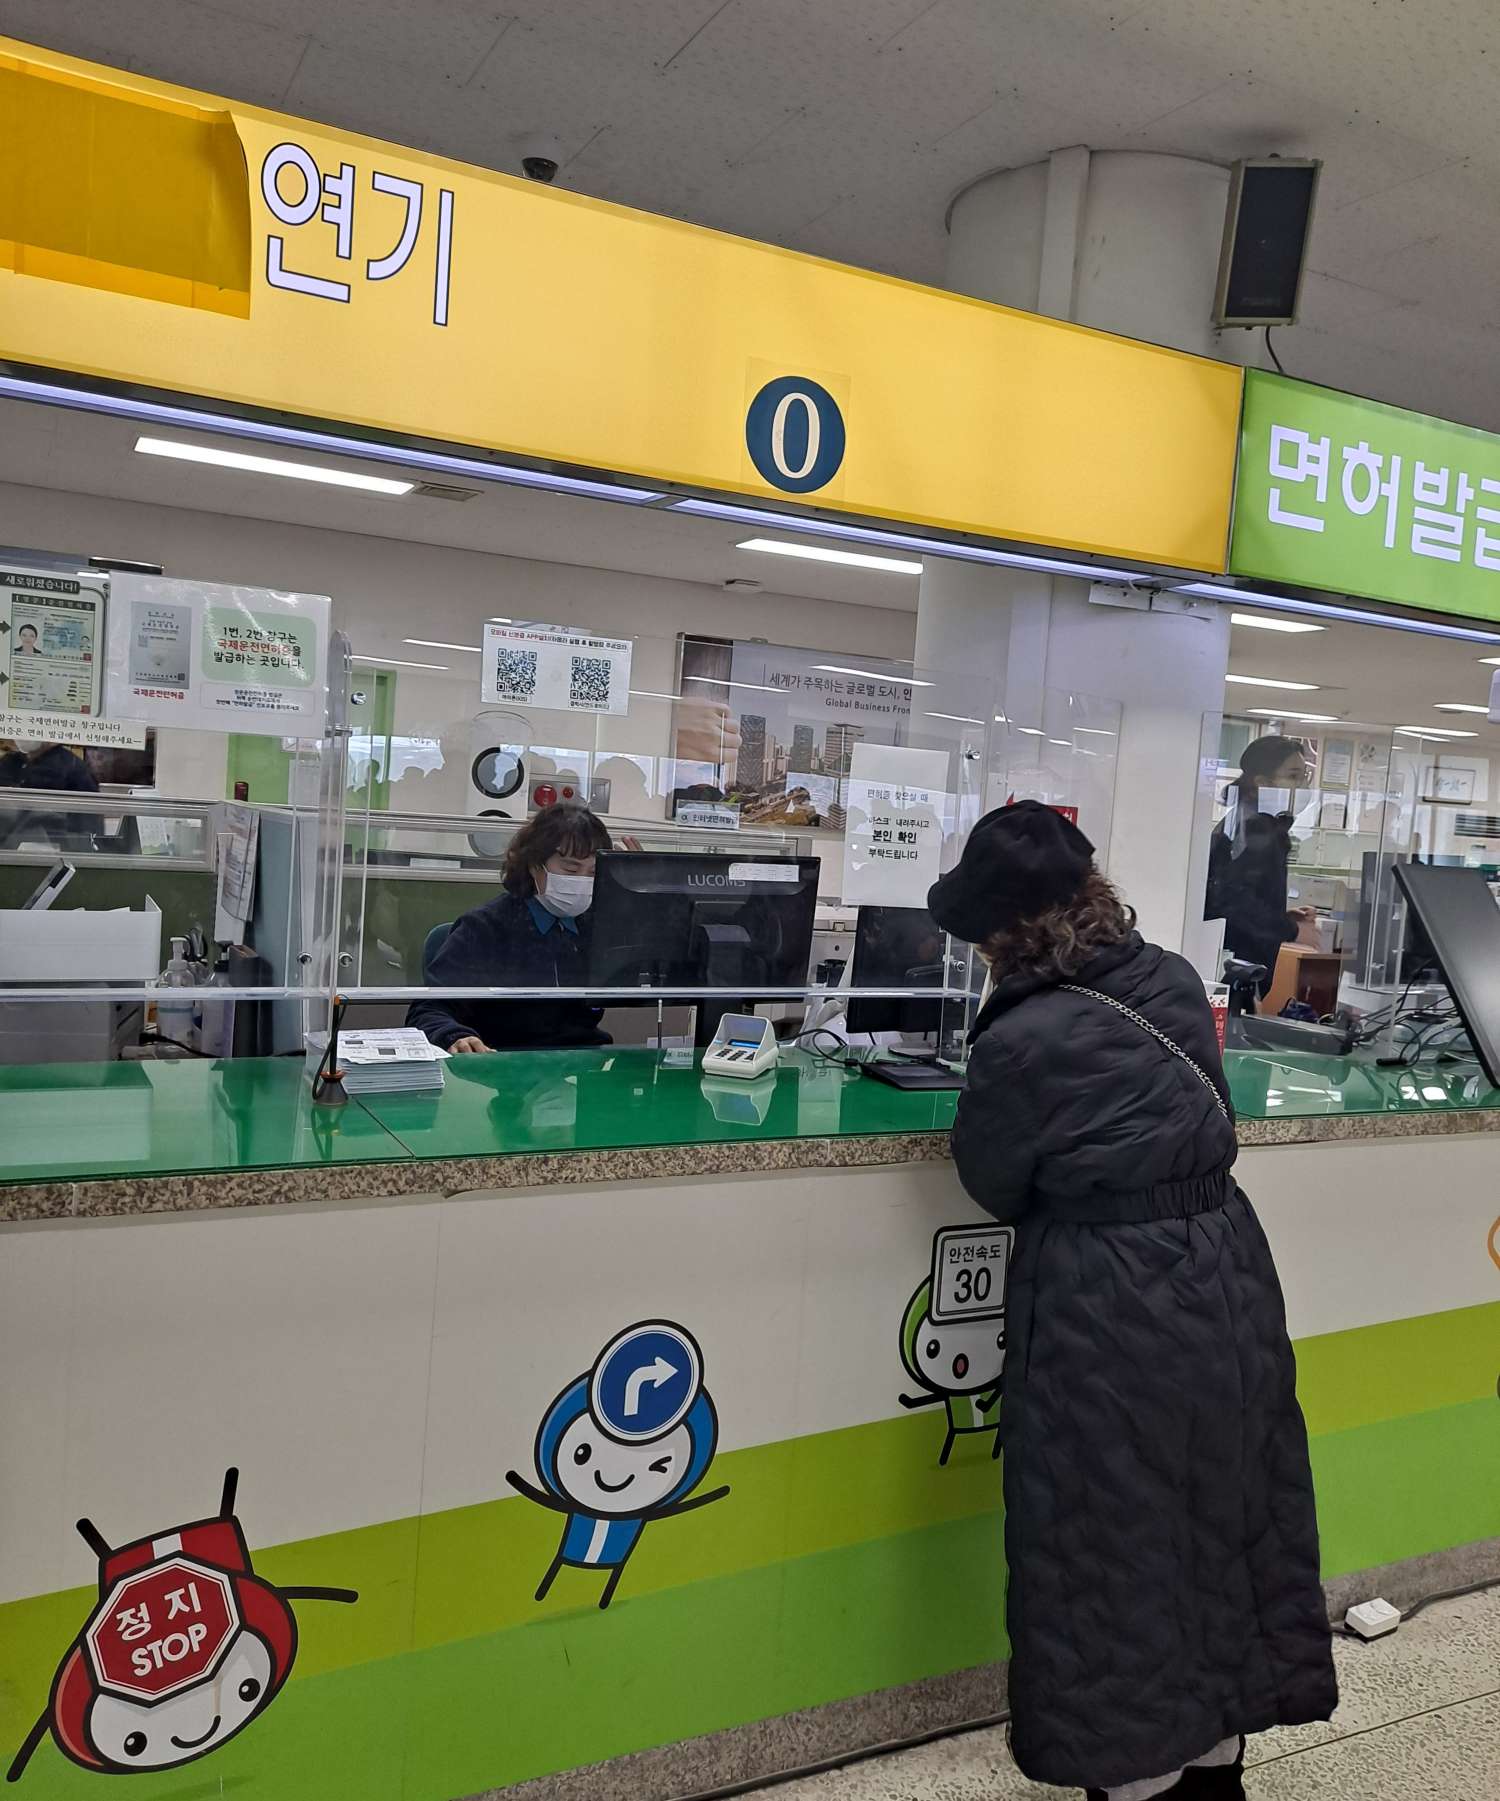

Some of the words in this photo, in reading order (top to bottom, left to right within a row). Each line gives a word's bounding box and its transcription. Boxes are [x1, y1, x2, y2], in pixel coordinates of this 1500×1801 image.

[261, 142, 454, 326] 연기
[772, 392, 820, 479] 0
[246, 629, 263, 640] 2번
[213, 651, 255, 665] 발급하는
[770, 672, 800, 688] 세계가
[804, 677, 844, 694] 주목하는
[846, 681, 875, 697] 글로벌
[825, 698, 852, 708] Global
[854, 701, 890, 712] Business
[896, 818, 930, 828] 내려주시고
[872, 829, 893, 843] 본인
[897, 831, 917, 844] 확인
[868, 848, 918, 860] 부탁드립니다
[949, 1244, 1001, 1264] 안전속도
[953, 1266, 992, 1304] 30
[131, 1623, 208, 1677] STOP
